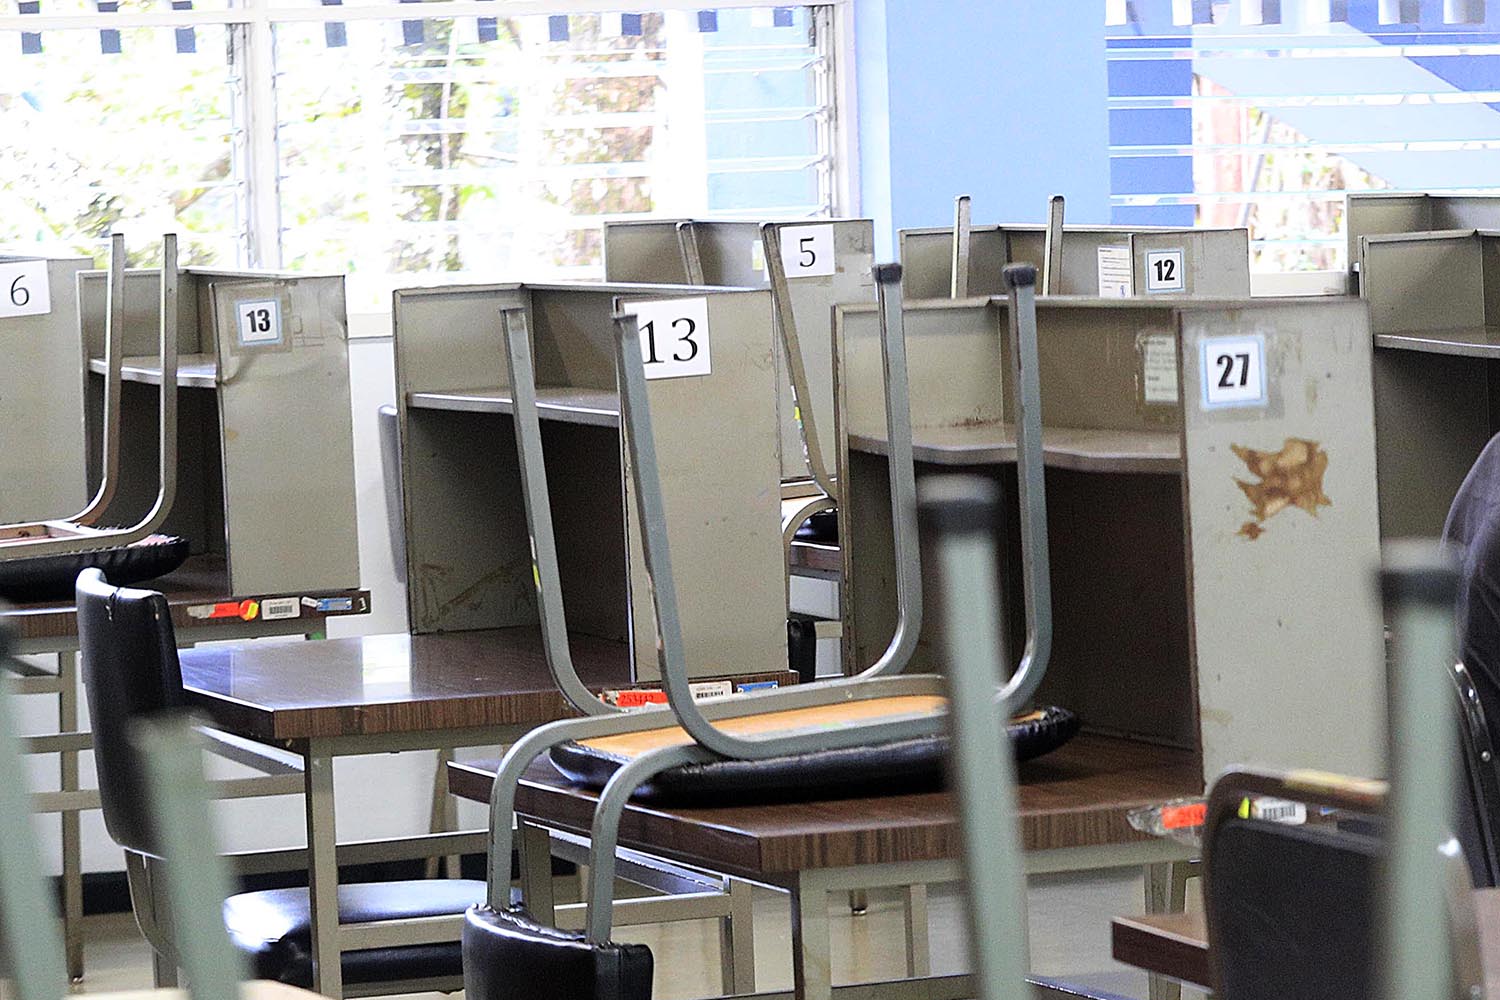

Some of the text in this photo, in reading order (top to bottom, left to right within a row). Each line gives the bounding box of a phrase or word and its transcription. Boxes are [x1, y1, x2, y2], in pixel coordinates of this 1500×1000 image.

[799, 237, 816, 268] 5
[1154, 259, 1176, 282] 12
[10, 274, 30, 306] 6
[246, 309, 272, 334] 13
[639, 317, 699, 366] 13
[1216, 353, 1251, 388] 27
